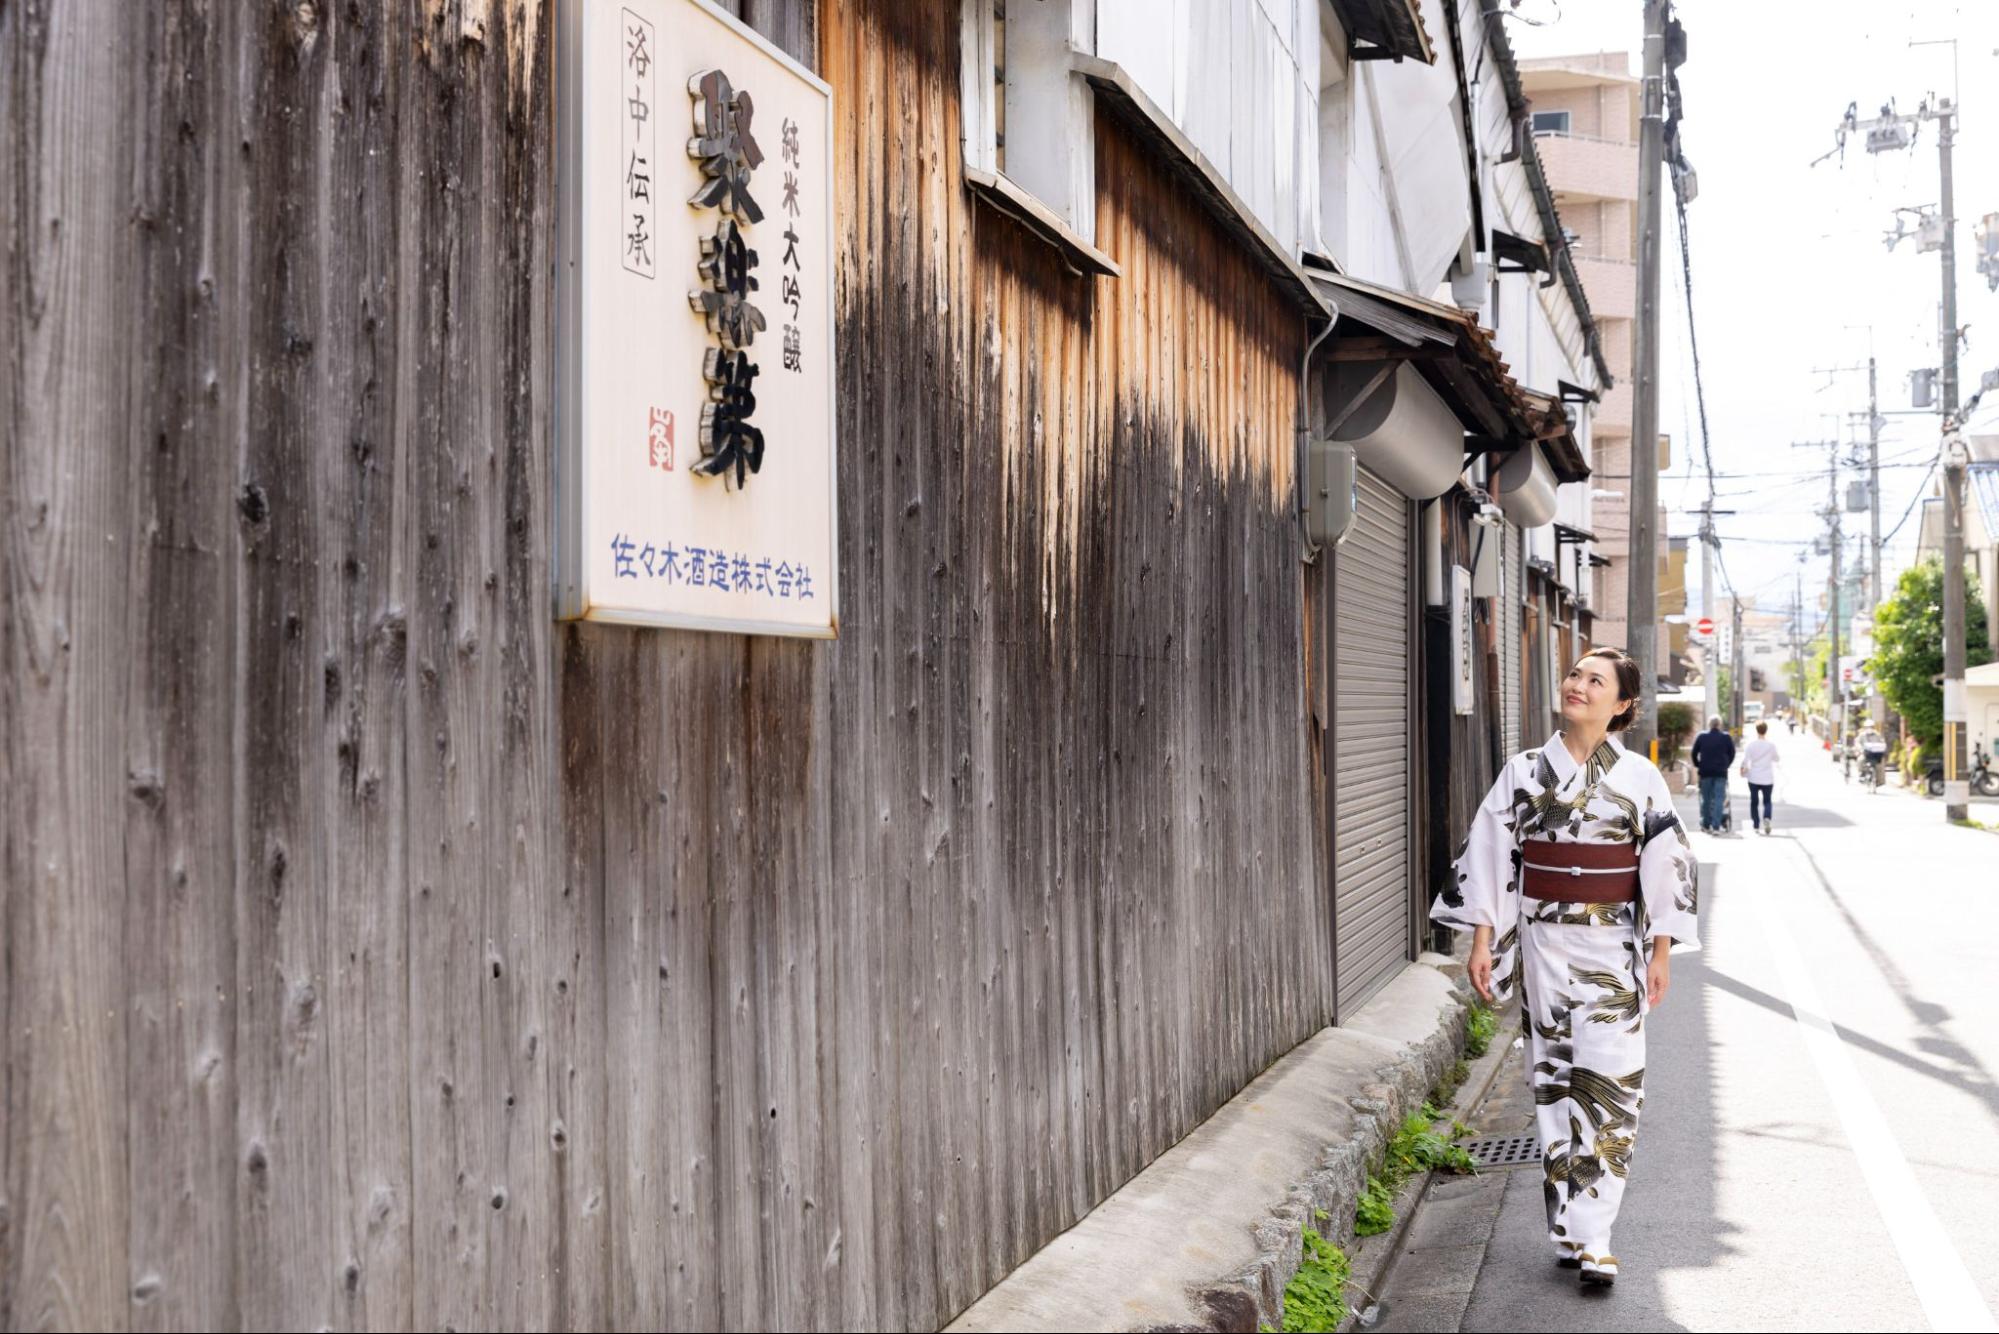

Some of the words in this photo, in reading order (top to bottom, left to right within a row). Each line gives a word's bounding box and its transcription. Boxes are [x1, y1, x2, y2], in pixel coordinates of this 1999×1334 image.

[626, 25, 652, 267] 洛中伝承
[781, 117, 802, 375] 純米大吟醸
[611, 532, 814, 600] 佐々木酒造株式会社
